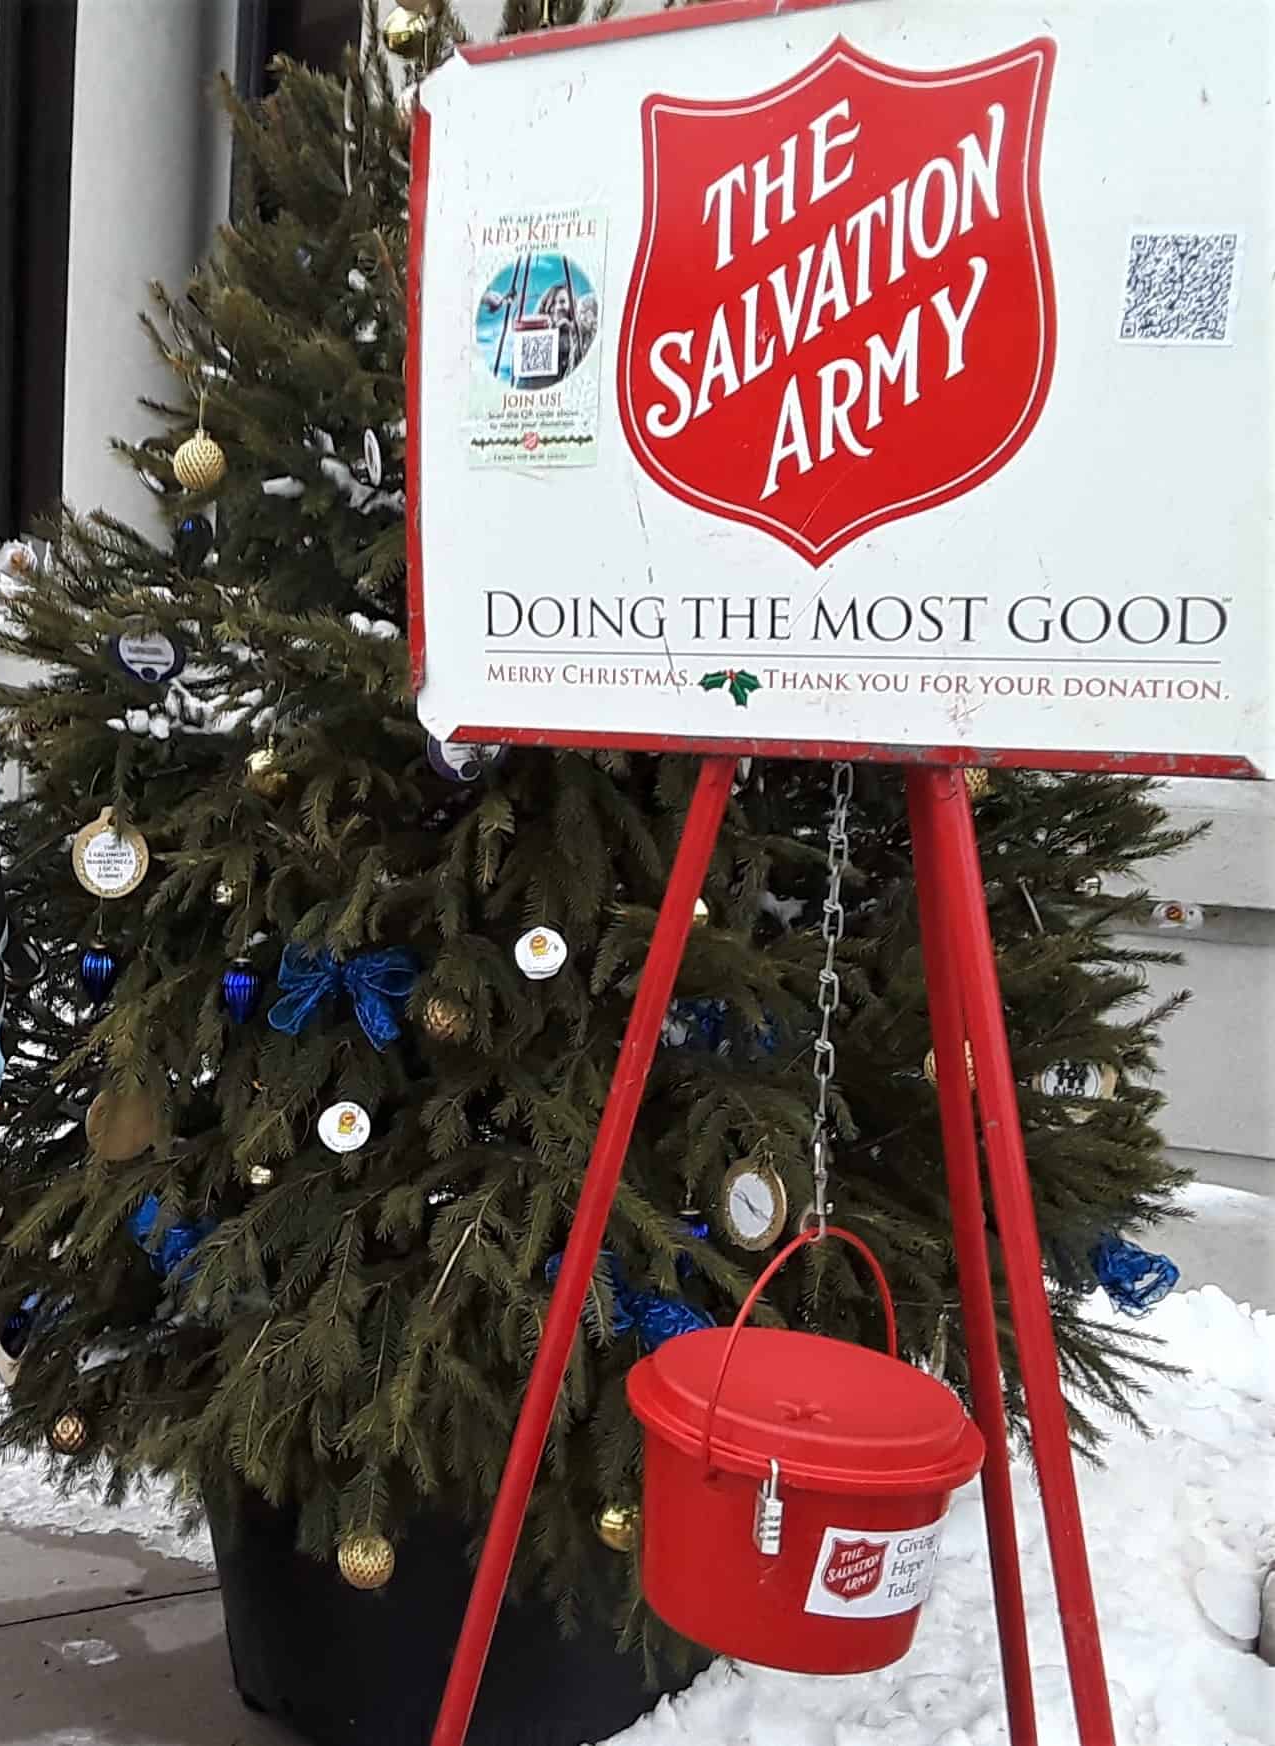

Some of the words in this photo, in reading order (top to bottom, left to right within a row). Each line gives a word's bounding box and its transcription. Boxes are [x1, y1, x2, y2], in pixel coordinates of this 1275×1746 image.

[702, 97, 861, 271] THE
[483, 226, 520, 246] RED
[527, 219, 597, 242] KETTLE
[645, 102, 1006, 439] SALVATION
[759, 256, 989, 501] ARMY
[501, 393, 535, 411] JOIN
[539, 391, 562, 407] US!
[483, 590, 666, 640] DOING
[681, 596, 792, 641] THE
[810, 596, 988, 643] MOST
[1007, 595, 1229, 646] GOOD
[487, 664, 555, 684] MERRY
[562, 664, 694, 688] CHRISTMAS.
[763, 668, 852, 692] THANK
[857, 672, 909, 693] YOU
[920, 674, 972, 695] FOR
[979, 675, 1055, 697] YOUR
[1063, 677, 1230, 701] DONATION.
[826, 1551, 882, 1584] SALVATION
[839, 1546, 866, 1564] THE
[841, 1567, 878, 1593] ARMY
